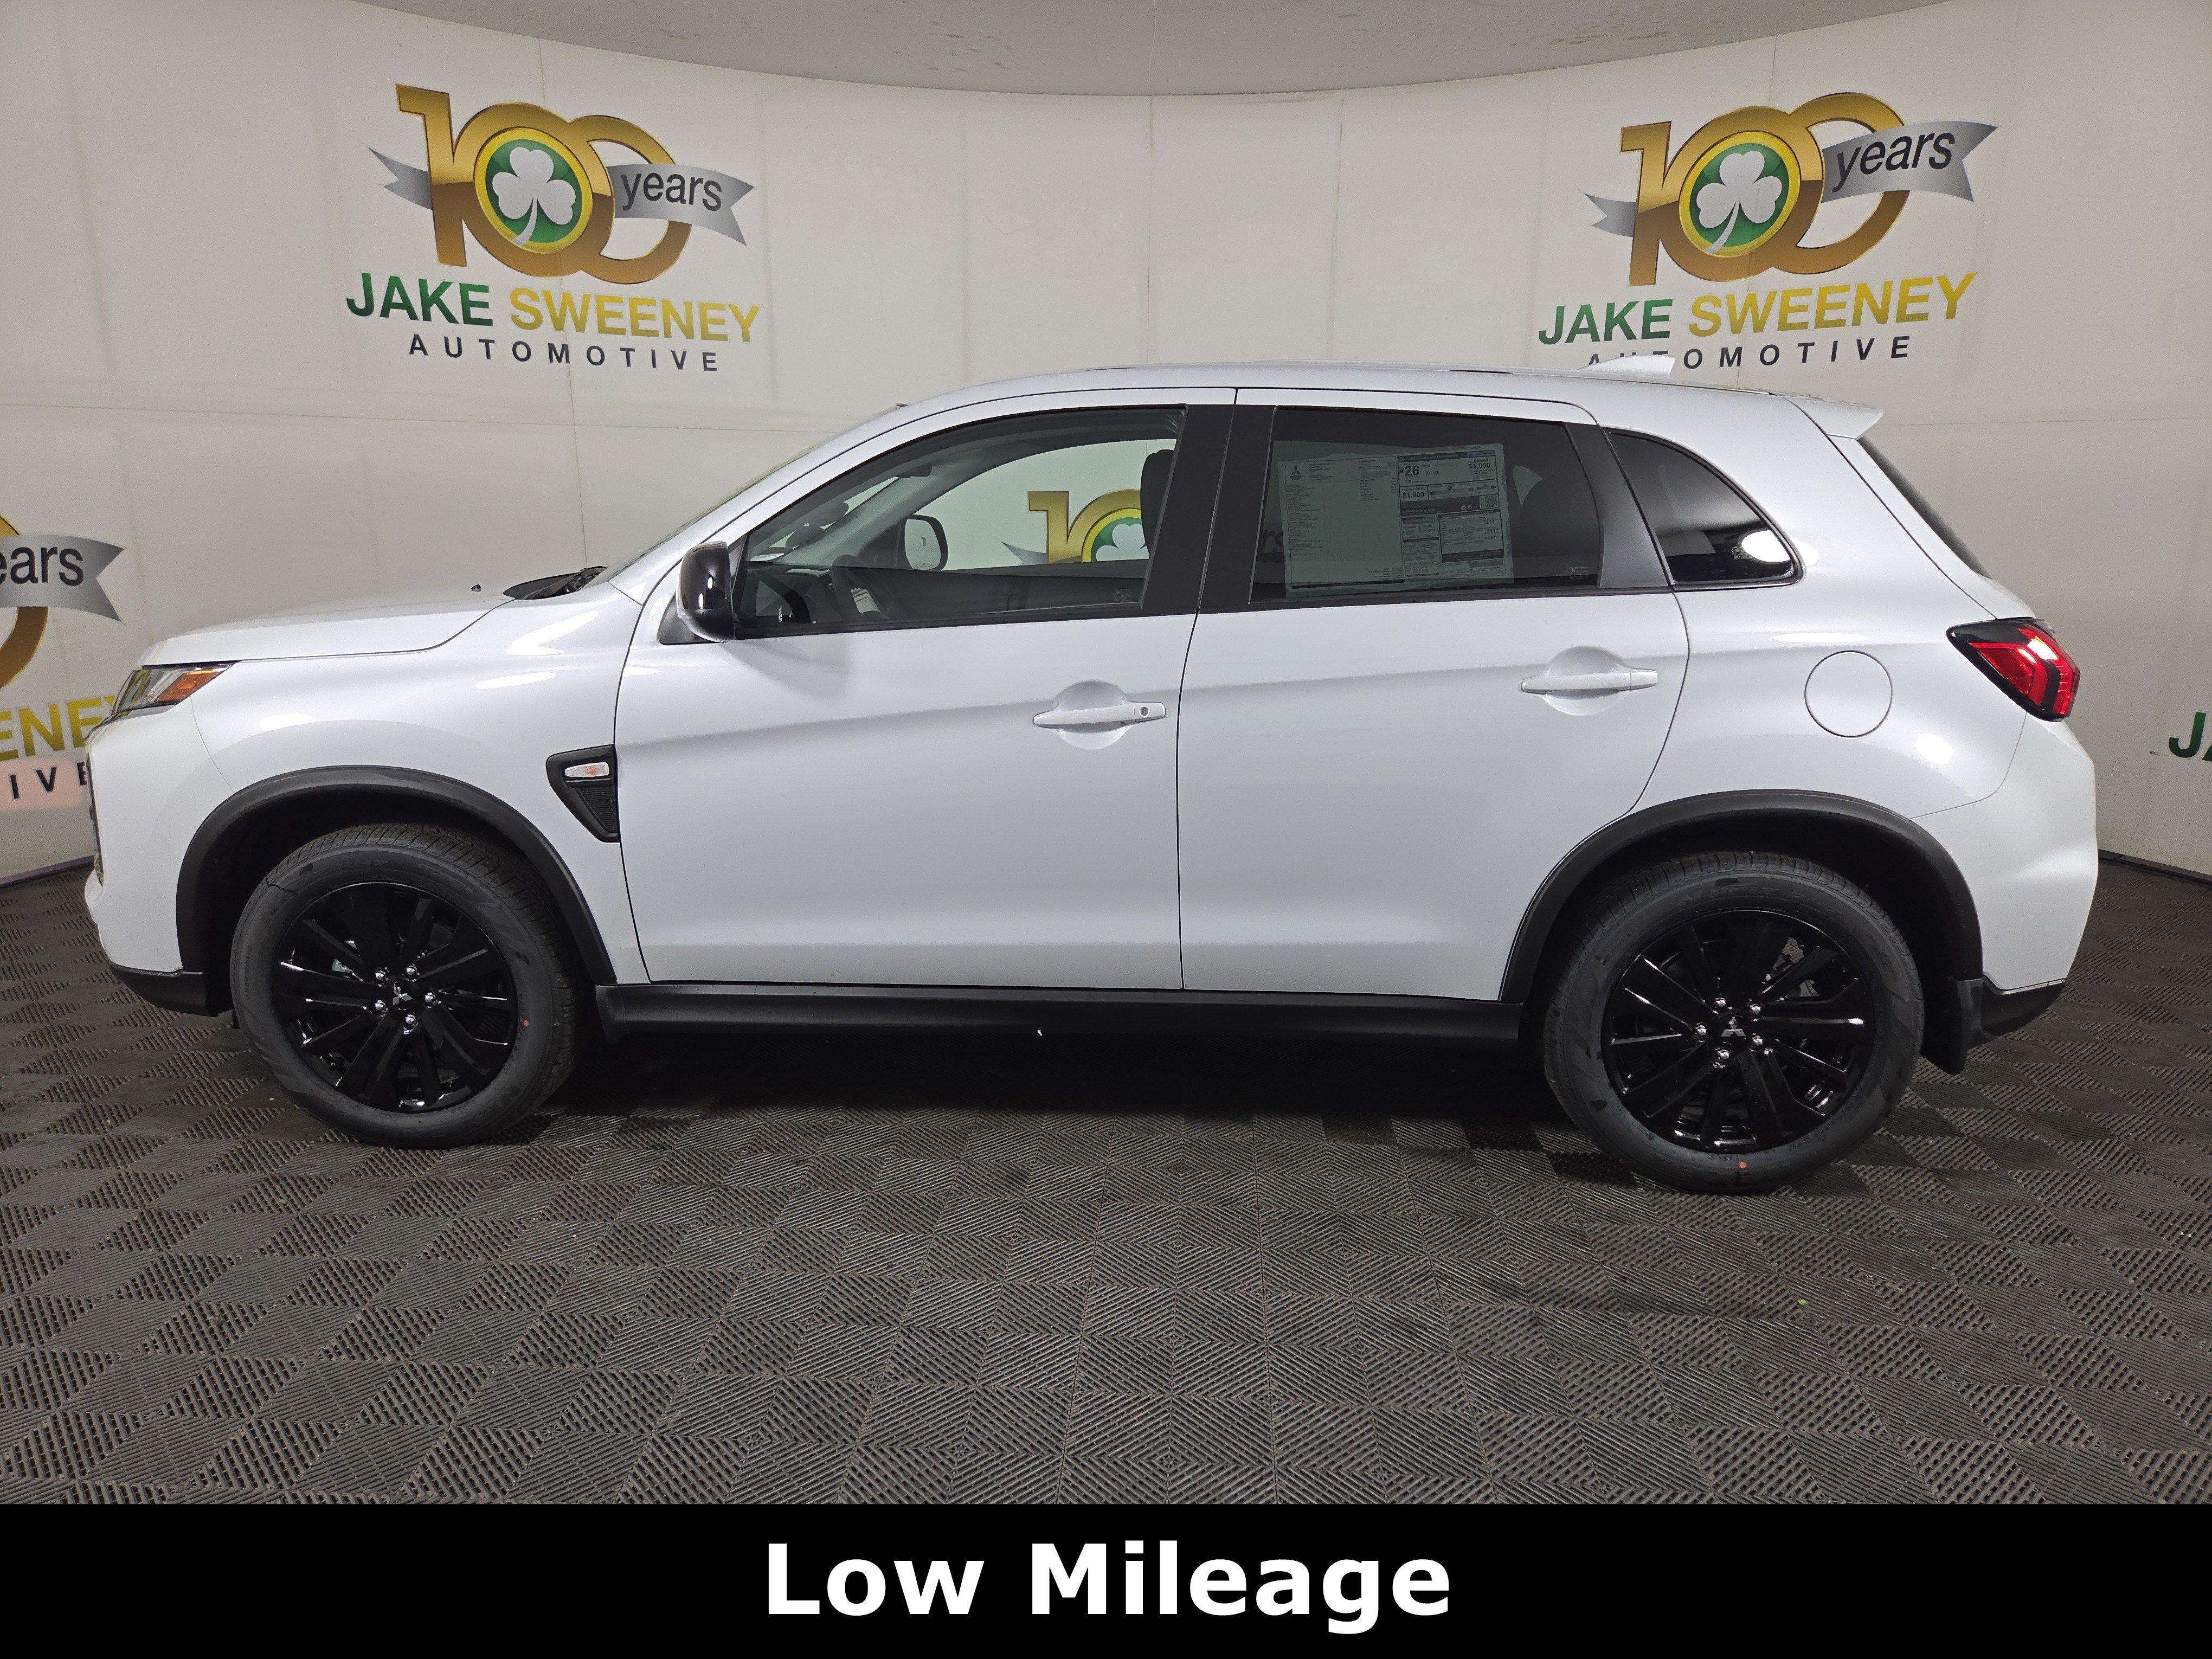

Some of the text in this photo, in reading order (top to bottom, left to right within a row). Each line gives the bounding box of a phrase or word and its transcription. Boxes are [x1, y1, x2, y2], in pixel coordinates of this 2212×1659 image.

[1831, 131, 1956, 192] years
[620, 173, 722, 211] years
[346, 272, 761, 343] JAKE SWEENEY
[1539, 272, 1977, 345] JAKE SWEENEY
[409, 334, 718, 372] AUTOMOTIVE
[1405, 465, 1419, 476] 26
[0, 546, 84, 586] ars
